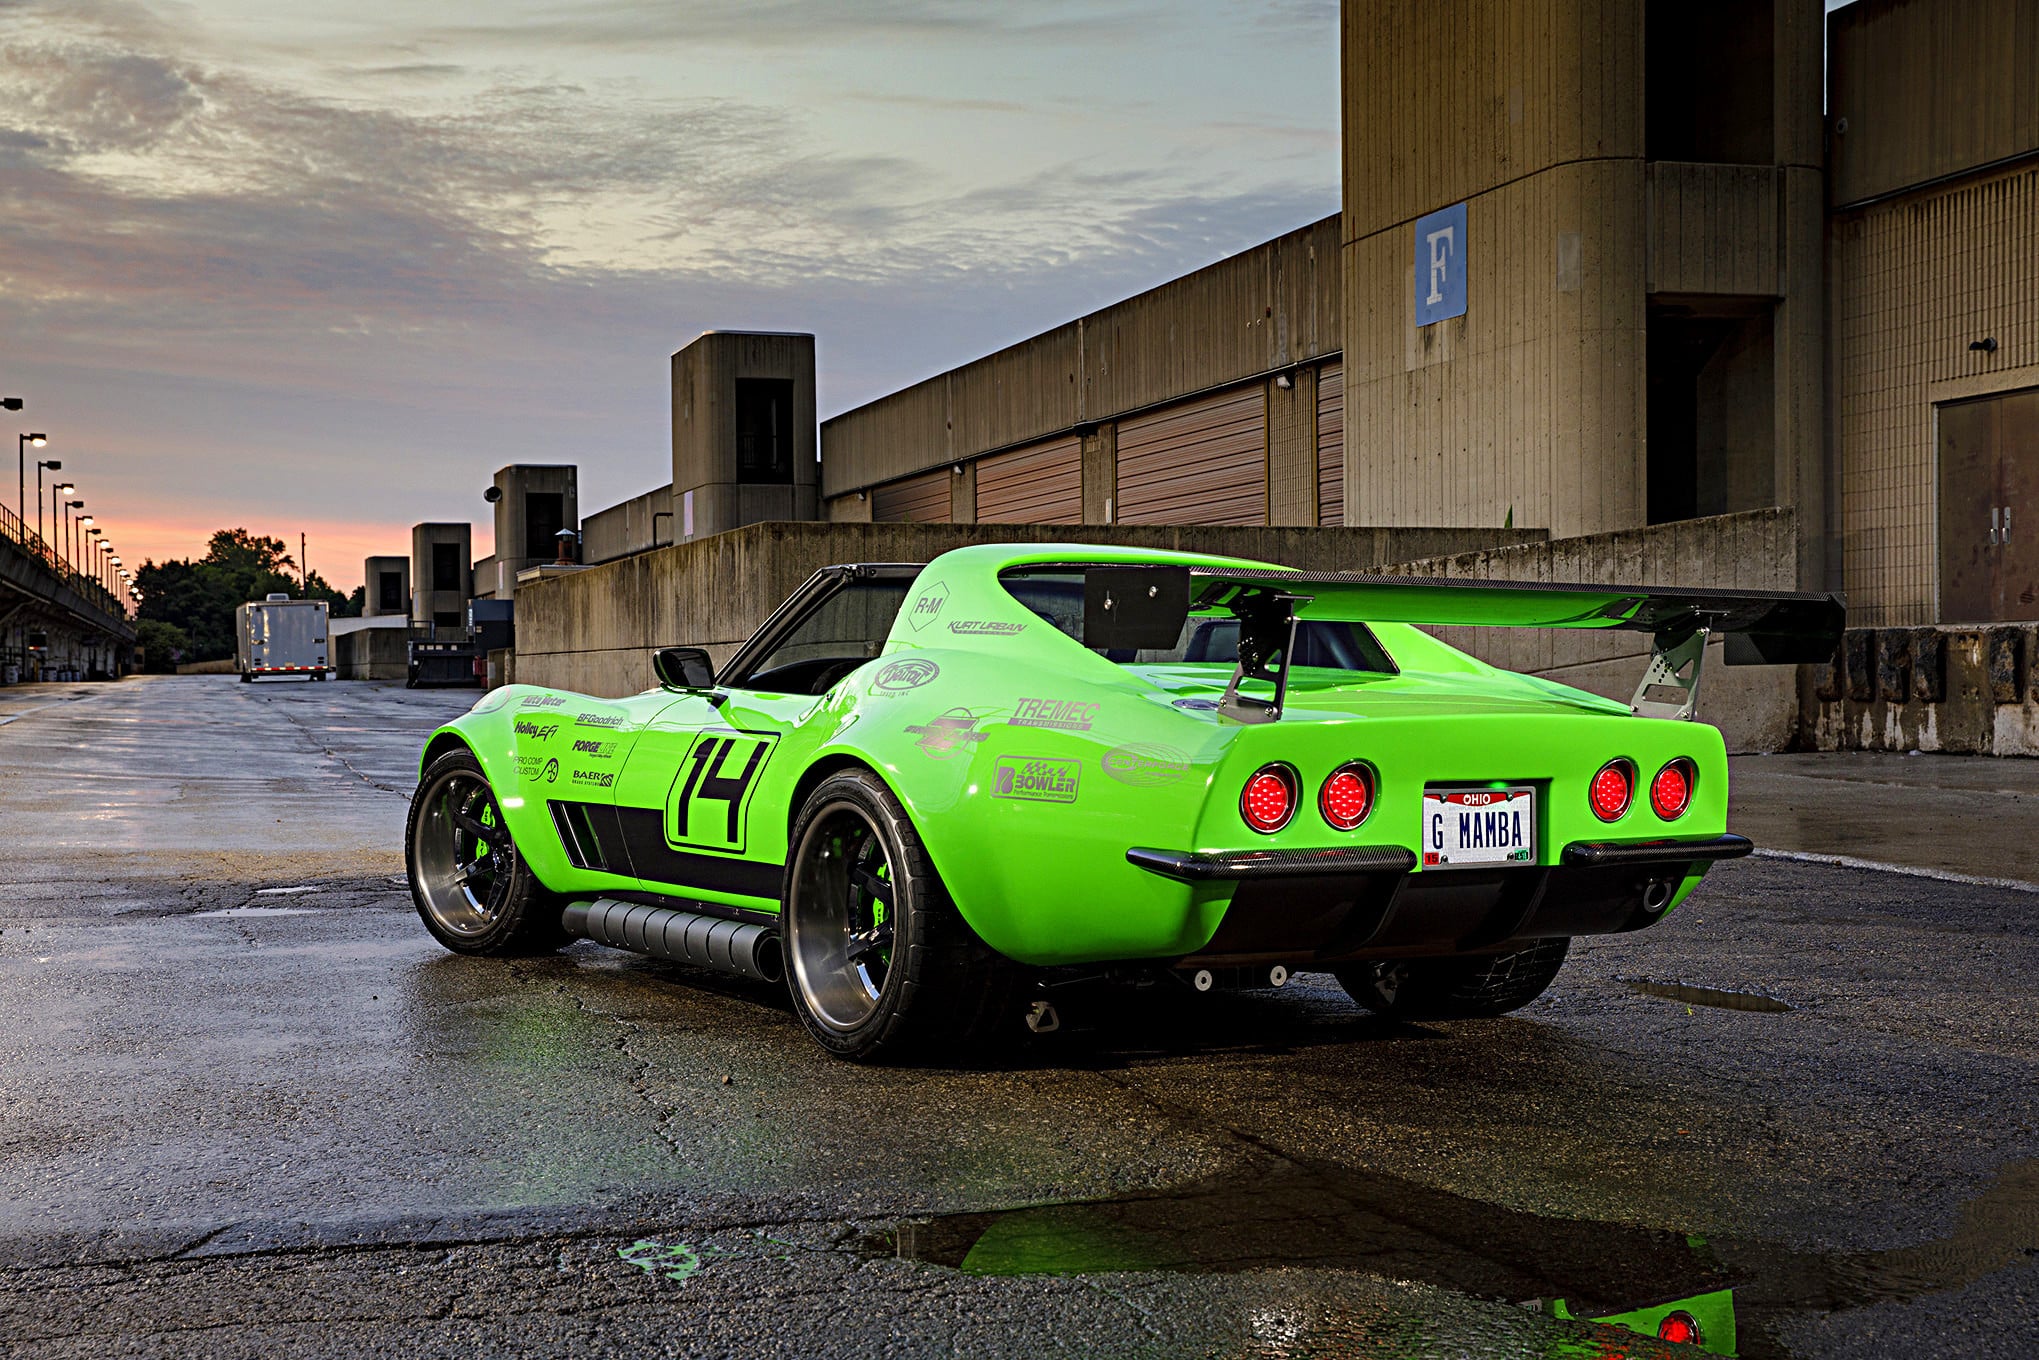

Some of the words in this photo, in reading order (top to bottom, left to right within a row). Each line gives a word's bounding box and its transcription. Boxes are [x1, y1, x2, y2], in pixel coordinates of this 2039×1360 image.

[1427, 226, 1454, 305] F
[947, 620, 980, 630] KURT
[979, 621, 1029, 632] URBAN
[1013, 697, 1101, 722] TREMEC
[575, 713, 624, 726] BFGoodrich
[1017, 718, 1083, 730] TRANSMISSIONS
[514, 721, 540, 739] Holley
[536, 725, 559, 741] EFI
[513, 756, 528, 765] PRO
[528, 757, 543, 765] COMP
[513, 766, 539, 776] CUSTOM
[573, 770, 601, 781] BAER
[1014, 774, 1076, 793] BOWLER
[677, 737, 771, 844] 14
[1463, 793, 1491, 805] OHIO
[1432, 813, 1443, 850] G
[1459, 810, 1522, 849] MAMBA
